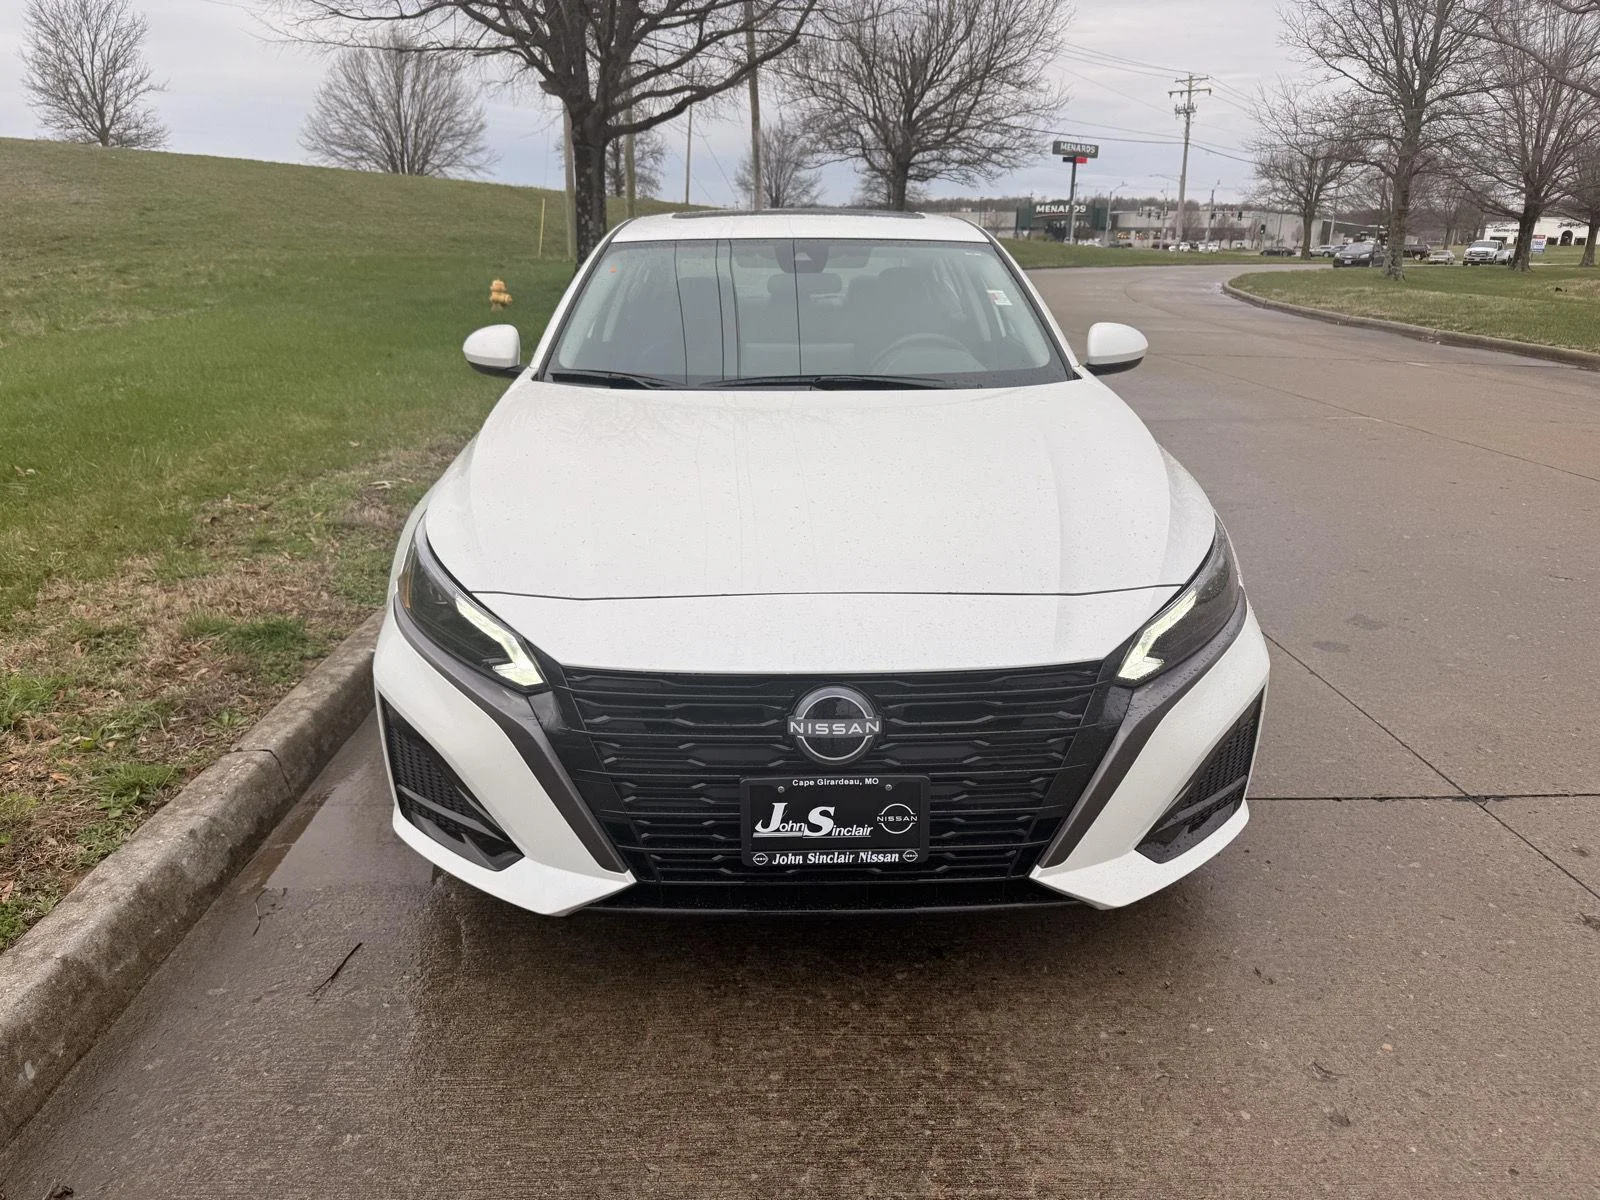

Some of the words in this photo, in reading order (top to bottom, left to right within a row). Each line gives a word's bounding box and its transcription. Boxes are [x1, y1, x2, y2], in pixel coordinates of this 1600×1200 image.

[1060, 142, 1096, 154] MENARDS
[790, 720, 880, 735] NISSAN
[792, 779, 814, 787] Cape
[817, 778, 862, 786] Girardeau,
[754, 802, 805, 833] John
[803, 806, 874, 837] Sinclair
[772, 853, 803, 865] John
[807, 851, 854, 864] Sinclair
[858, 851, 899, 863] Nissan
